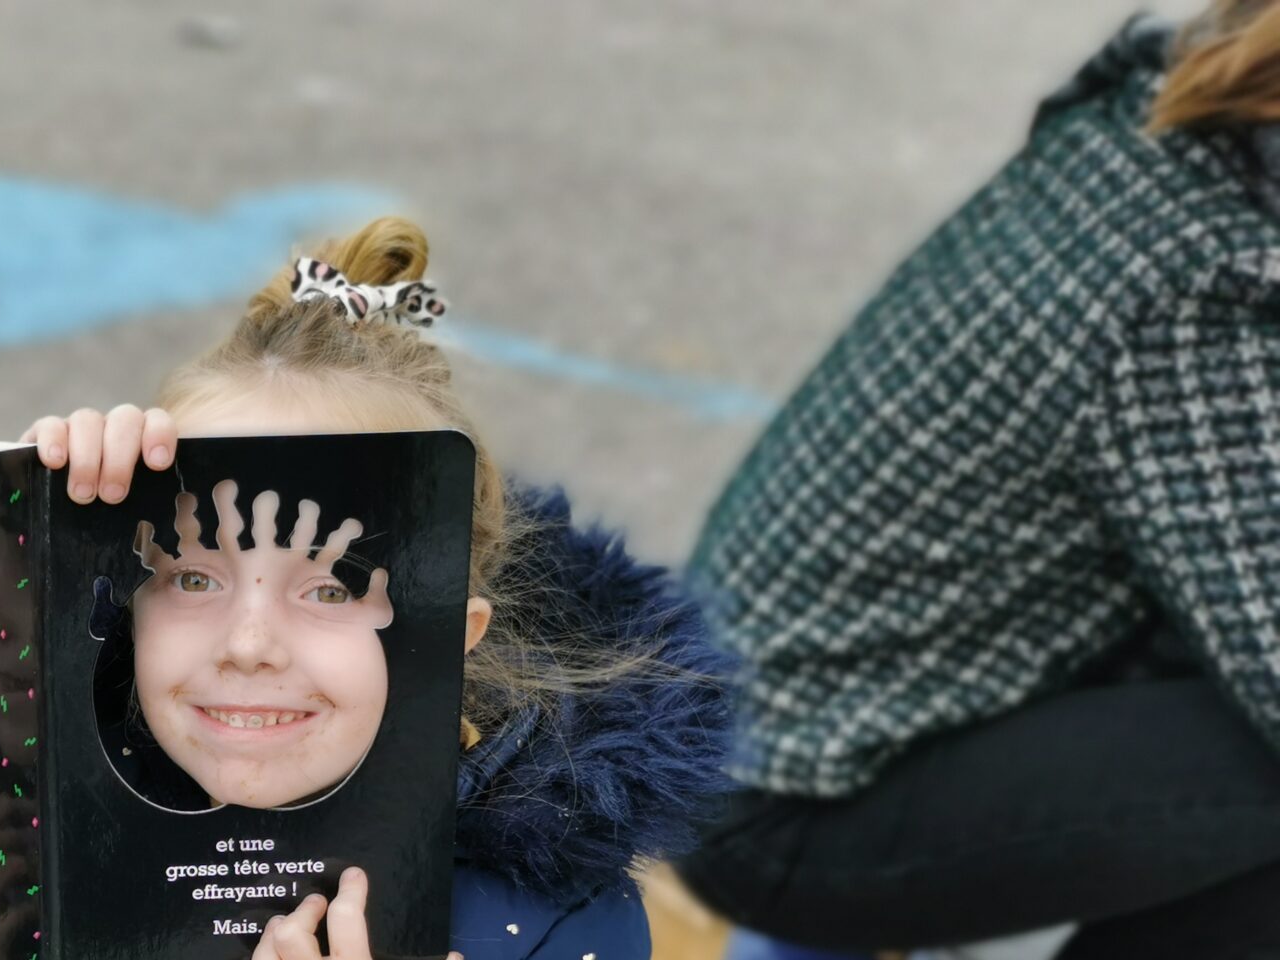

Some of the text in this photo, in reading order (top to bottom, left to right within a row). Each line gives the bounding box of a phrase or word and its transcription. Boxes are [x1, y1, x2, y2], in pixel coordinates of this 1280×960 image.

[215, 837, 275, 853] et une
[165, 858, 325, 882] grosse tête verte
[191, 881, 298, 903] effrayante !
